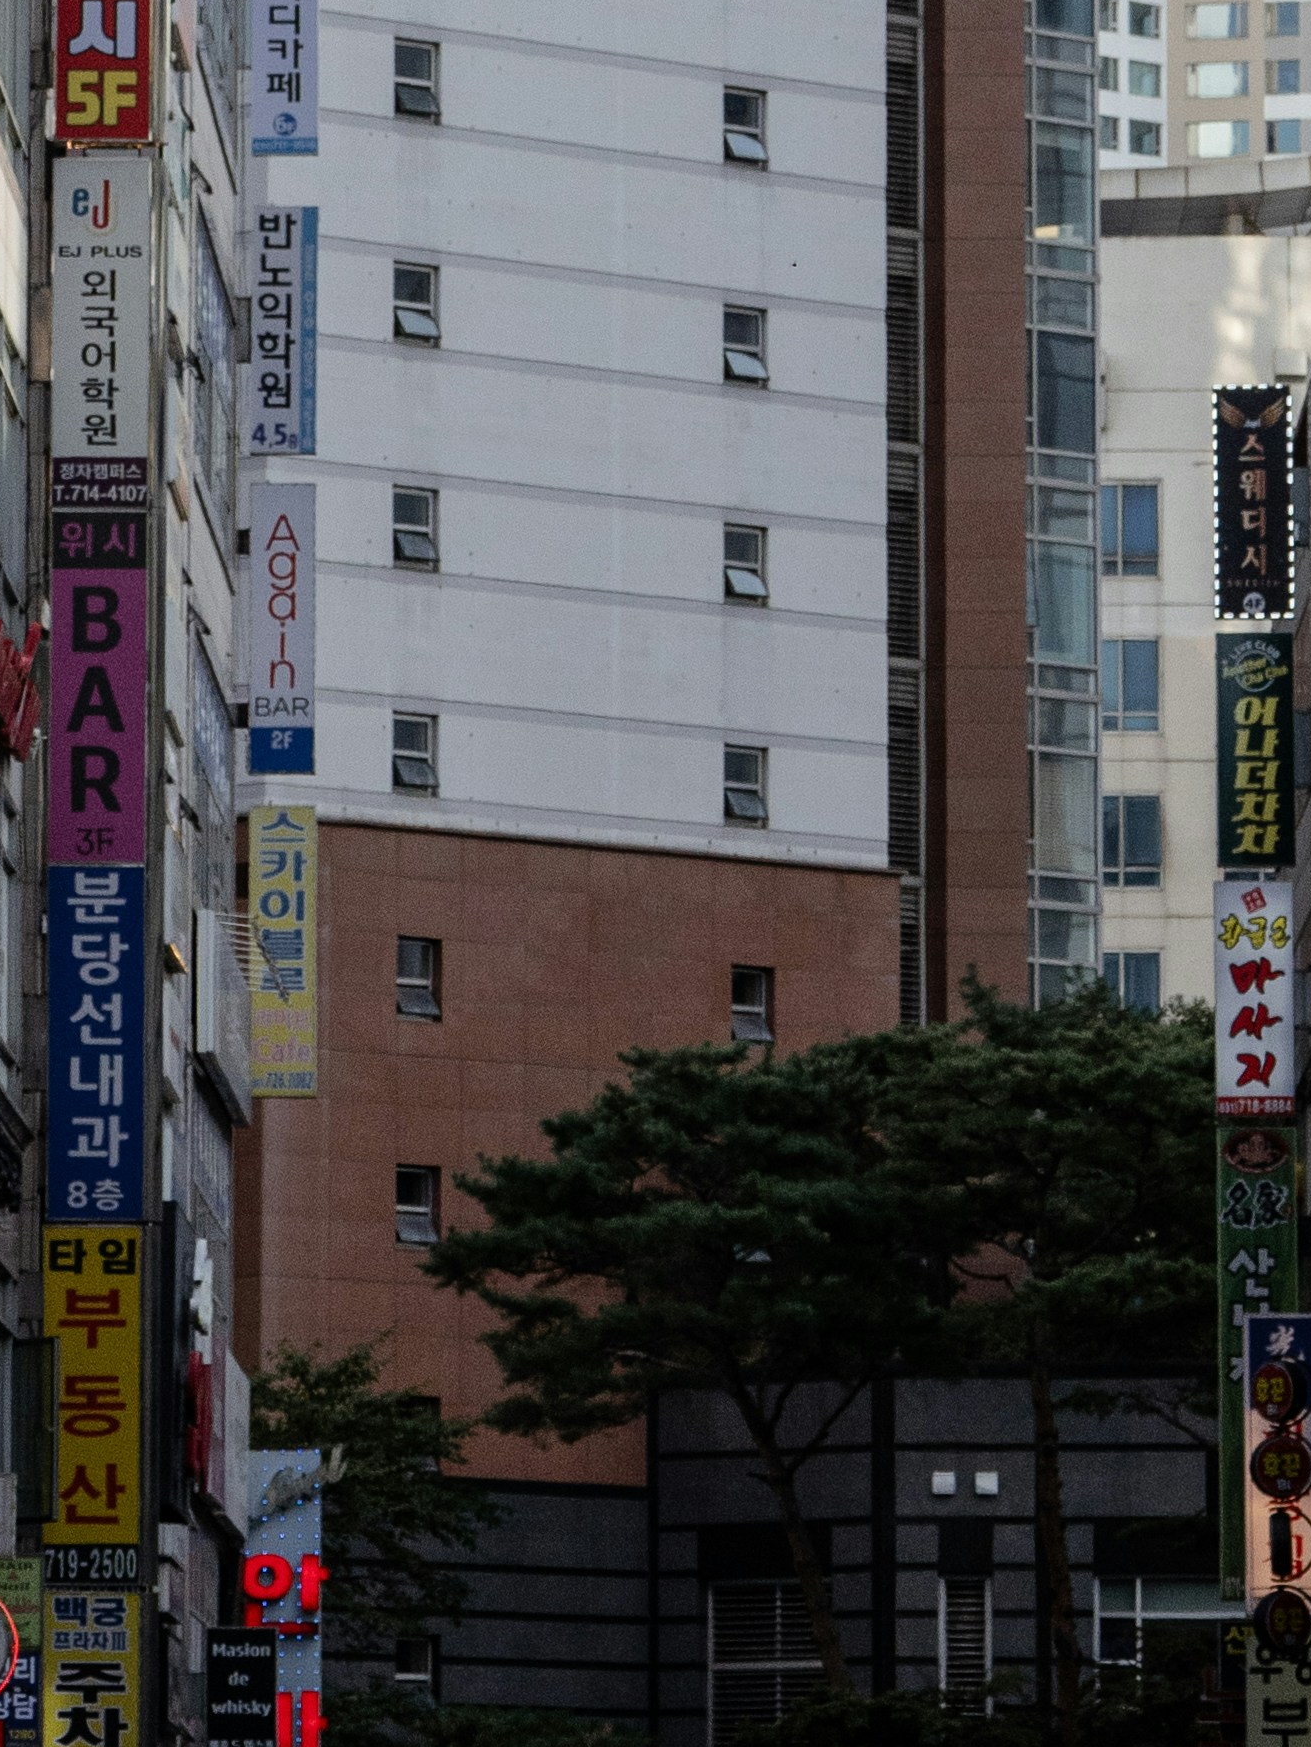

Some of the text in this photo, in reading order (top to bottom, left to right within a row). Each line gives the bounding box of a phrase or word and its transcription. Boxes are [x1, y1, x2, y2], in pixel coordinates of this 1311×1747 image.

[65, 71, 139, 128] 5F
[90, 246, 143, 258] PLUS
[80, 269, 121, 448] 외국어학원
[59, 463, 143, 482] 정자캠퍼스
[54, 484, 148, 506] T.714-4107
[1240, 436, 1268, 577] 스웨디시
[60, 522, 137, 559] 위시
[255, 514, 310, 717] Again BAR
[69, 585, 121, 814] BAR
[270, 731, 292, 749] 2F
[1231, 695, 1281, 855] 어나더차차
[76, 829, 115, 855] 3F
[67, 871, 131, 1169] 분당선내과
[1230, 957, 1285, 1087] 마사지
[67, 1181, 125, 1212] 8층
[49, 1237, 137, 1274] 타임
[60, 1289, 128, 1528] 부동산
[46, 1547, 137, 1581] 719-2500
[53, 1597, 126, 1627] 백궁
[227, 1669, 250, 1687] de
[211, 1698, 272, 1719] whisky
